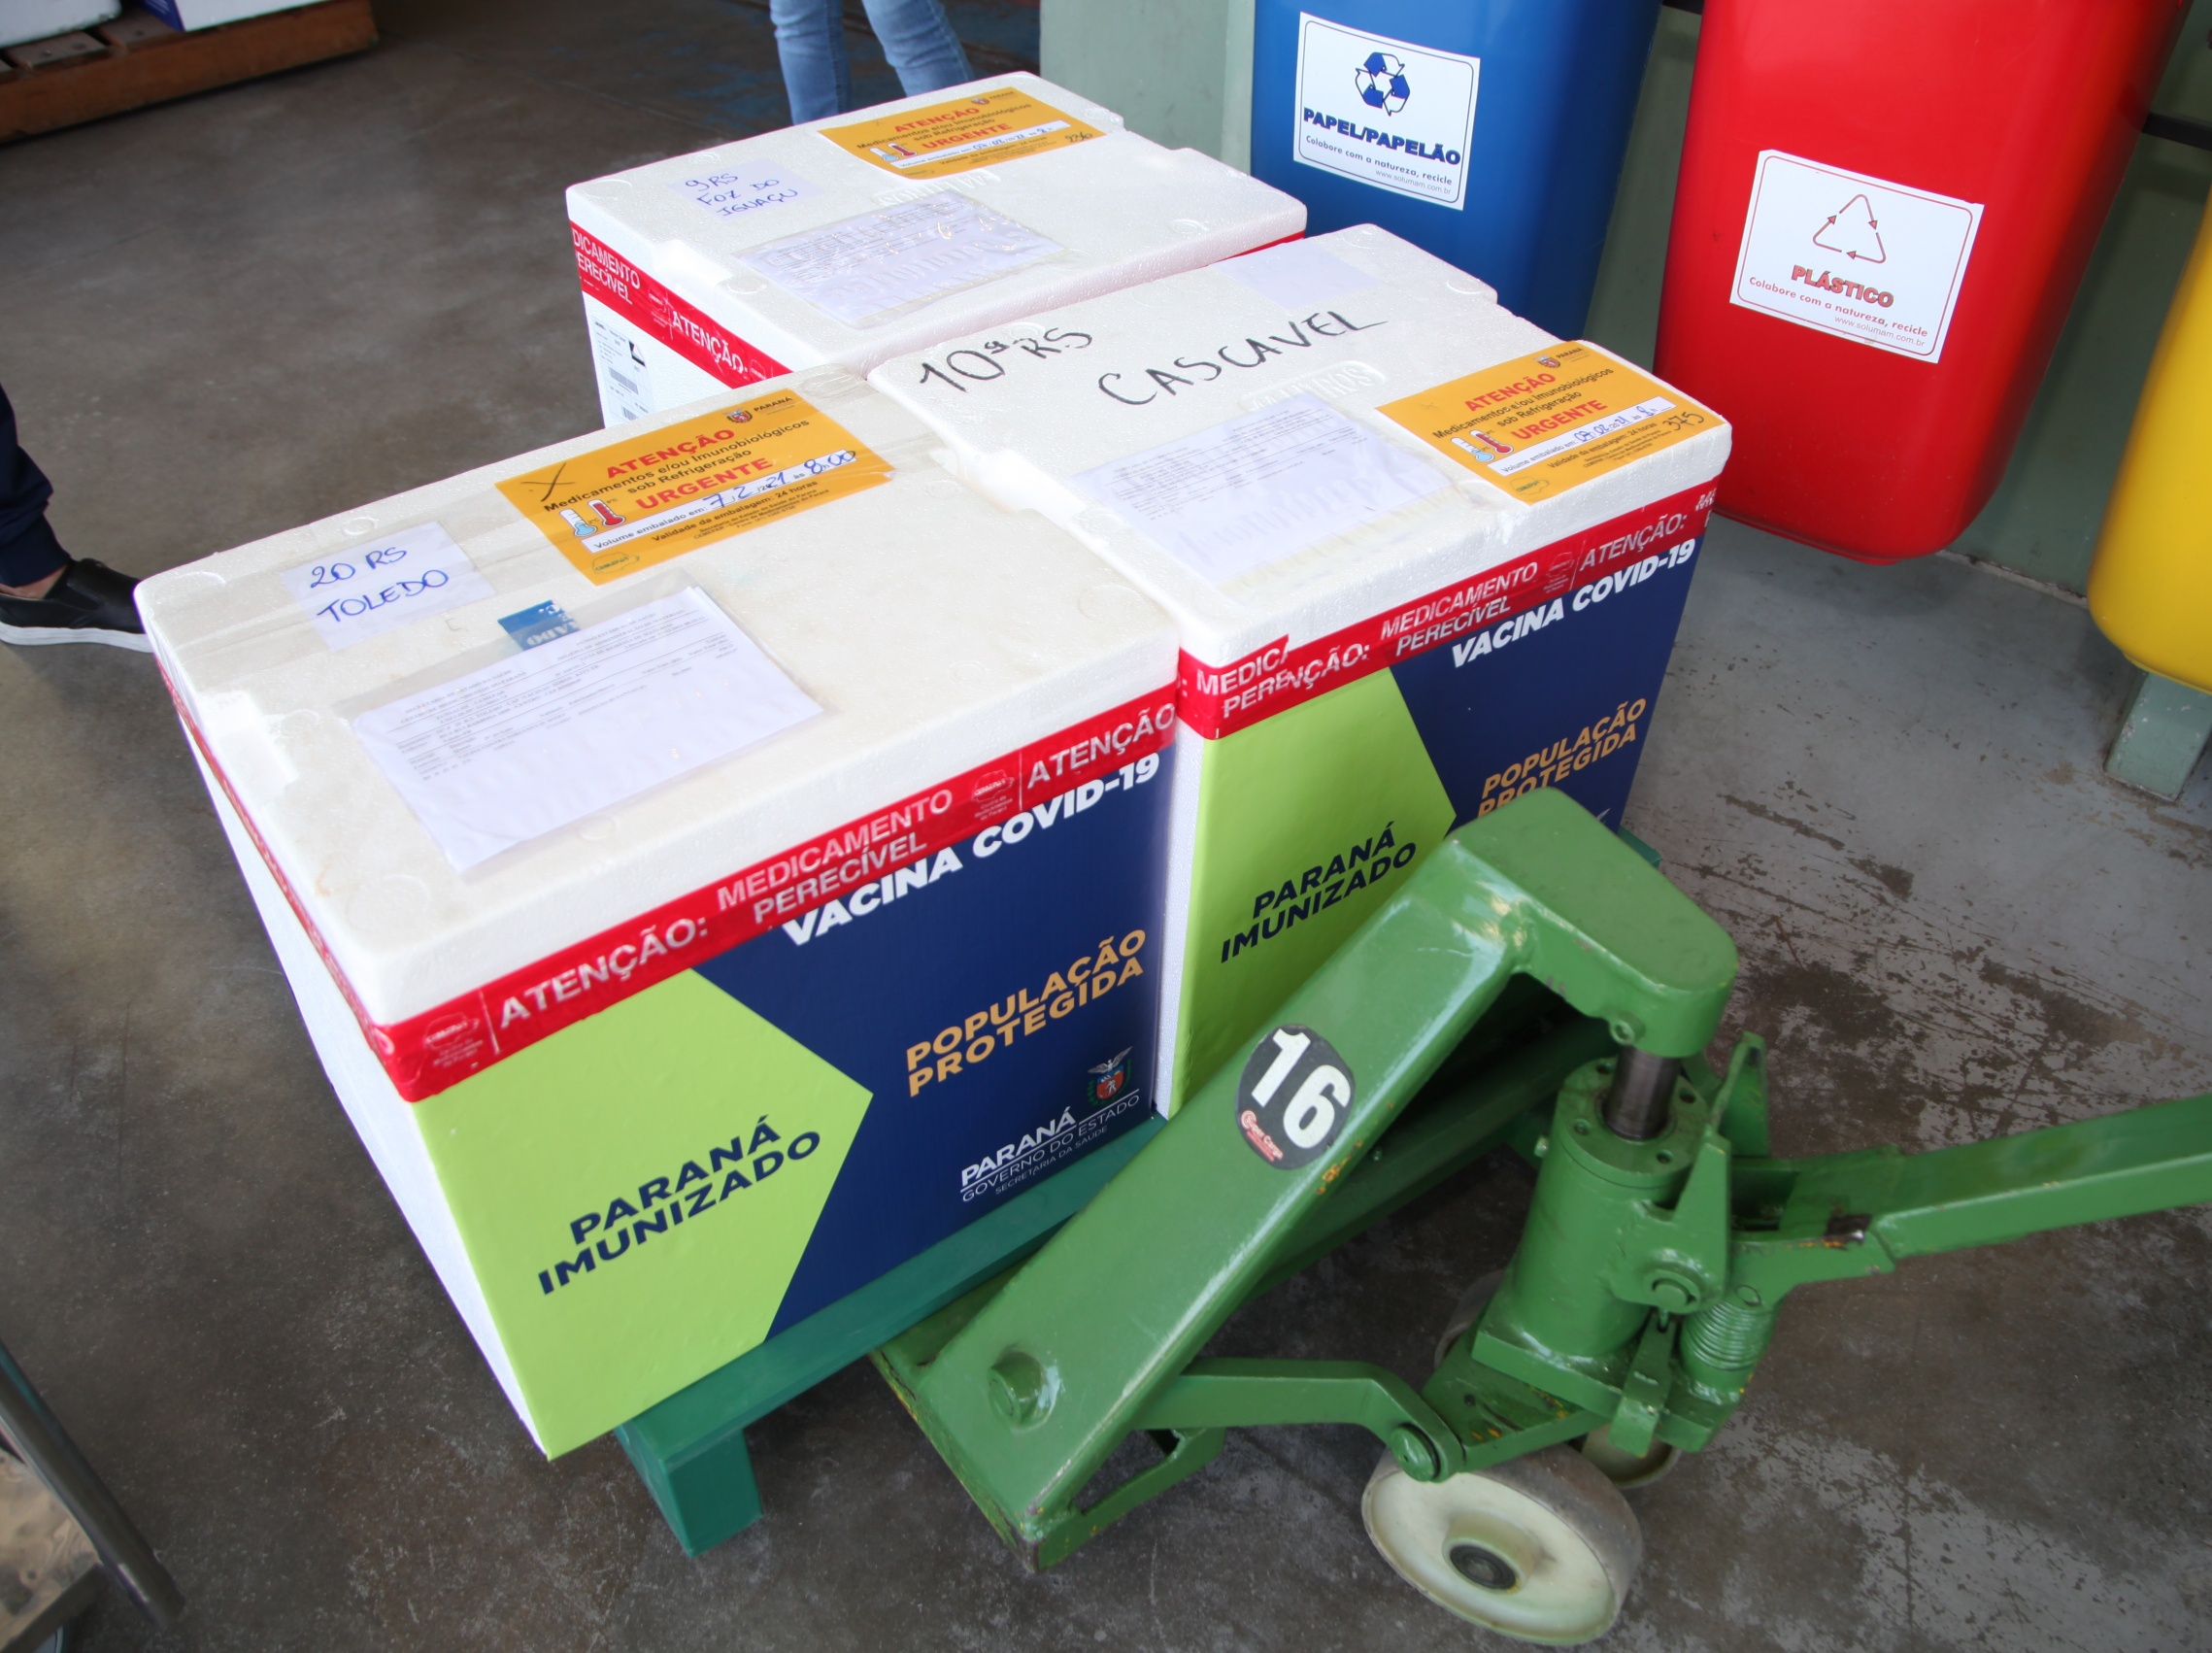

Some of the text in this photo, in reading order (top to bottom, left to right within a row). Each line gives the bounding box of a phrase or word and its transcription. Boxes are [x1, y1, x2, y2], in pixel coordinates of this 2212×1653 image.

[894, 108, 979, 132] ATENÇÃO
[922, 123, 1009, 148] URGENTE
[1303, 107, 1460, 165] PAPEL/PAPELÃO
[1306, 135, 1343, 154] Colabore
[1345, 151, 1363, 161] com
[1374, 158, 1420, 179] natureza,
[1422, 172, 1453, 186] recicle
[1375, 169, 1452, 195] www.solumam.com.br
[697, 179, 780, 206] FOZ DO
[716, 188, 798, 217] IGUAÇU
[572, 229, 641, 289] DICAMENTO
[576, 251, 633, 305] ERECÍVEL
[1791, 264, 1894, 308] PLÁSTICO
[1749, 276, 1928, 337] Colabore com a natureza, recicle
[1834, 316, 1926, 348] www.solumam.com.br
[672, 310, 749, 380] ATENÇÃO:
[1013, 327, 1092, 359] RS
[1098, 311, 1389, 405] CASCAVEL
[754, 397, 791, 411] PARANÁ
[1432, 368, 1613, 437] Medicamentos e/ou Imunobiológicos
[1465, 373, 1555, 410] ATENÇÃO
[1496, 391, 1581, 426] sob Refrigeração
[1512, 400, 1606, 438] URGENTE
[1661, 411, 1704, 430] 375
[544, 421, 808, 511] Medicamentos e/ou Imunobiológicos
[607, 429, 733, 477] ATENÇÃO
[627, 450, 751, 492] sob Refrigeração
[636, 458, 771, 508] URGENTE
[1501, 459, 1529, 472] Volume
[594, 532, 633, 548] Volume
[636, 514, 686, 533] embalado
[652, 523, 696, 540] Validade
[714, 497, 770, 520] embalagem:
[788, 481, 817, 492] horas
[310, 546, 408, 589] 20 RS
[1579, 513, 1689, 571] ATENÇÃO:
[317, 569, 450, 623] TOLEDO
[1381, 561, 1538, 639] MEDICAMENTO
[1452, 598, 1564, 667] VACINA
[1572, 538, 1695, 611] COVID-19
[1395, 596, 1511, 657] PERECÍVEL
[1027, 703, 1176, 790] ATENÇÃO
[1478, 724, 1636, 818] PROTEGIDA
[1482, 698, 1647, 798] POPULAÇÃO
[717, 790, 953, 910] MEDICAMENTO
[754, 832, 927, 924] PERECÍVEL
[782, 753, 1159, 946] VACINA COVID-19
[1253, 821, 1394, 920] PARANÁ
[1221, 842, 1417, 963] IMUNIZADO
[500, 917, 708, 1029] ATENÇÃO:
[906, 929, 1146, 1071] POPULAÇÃO
[908, 957, 1144, 1097] PROTEGIDA
[1252, 1029, 1351, 1149] 16
[960, 1106, 1076, 1187] PARANÁ
[962, 1096, 1139, 1202] GOVERNO DO ESTADO
[995, 1126, 1108, 1195] SECRETARIA DA SAÚDE
[570, 1114, 781, 1245] PARANÁ
[538, 1131, 821, 1296] IMUNIZADO
